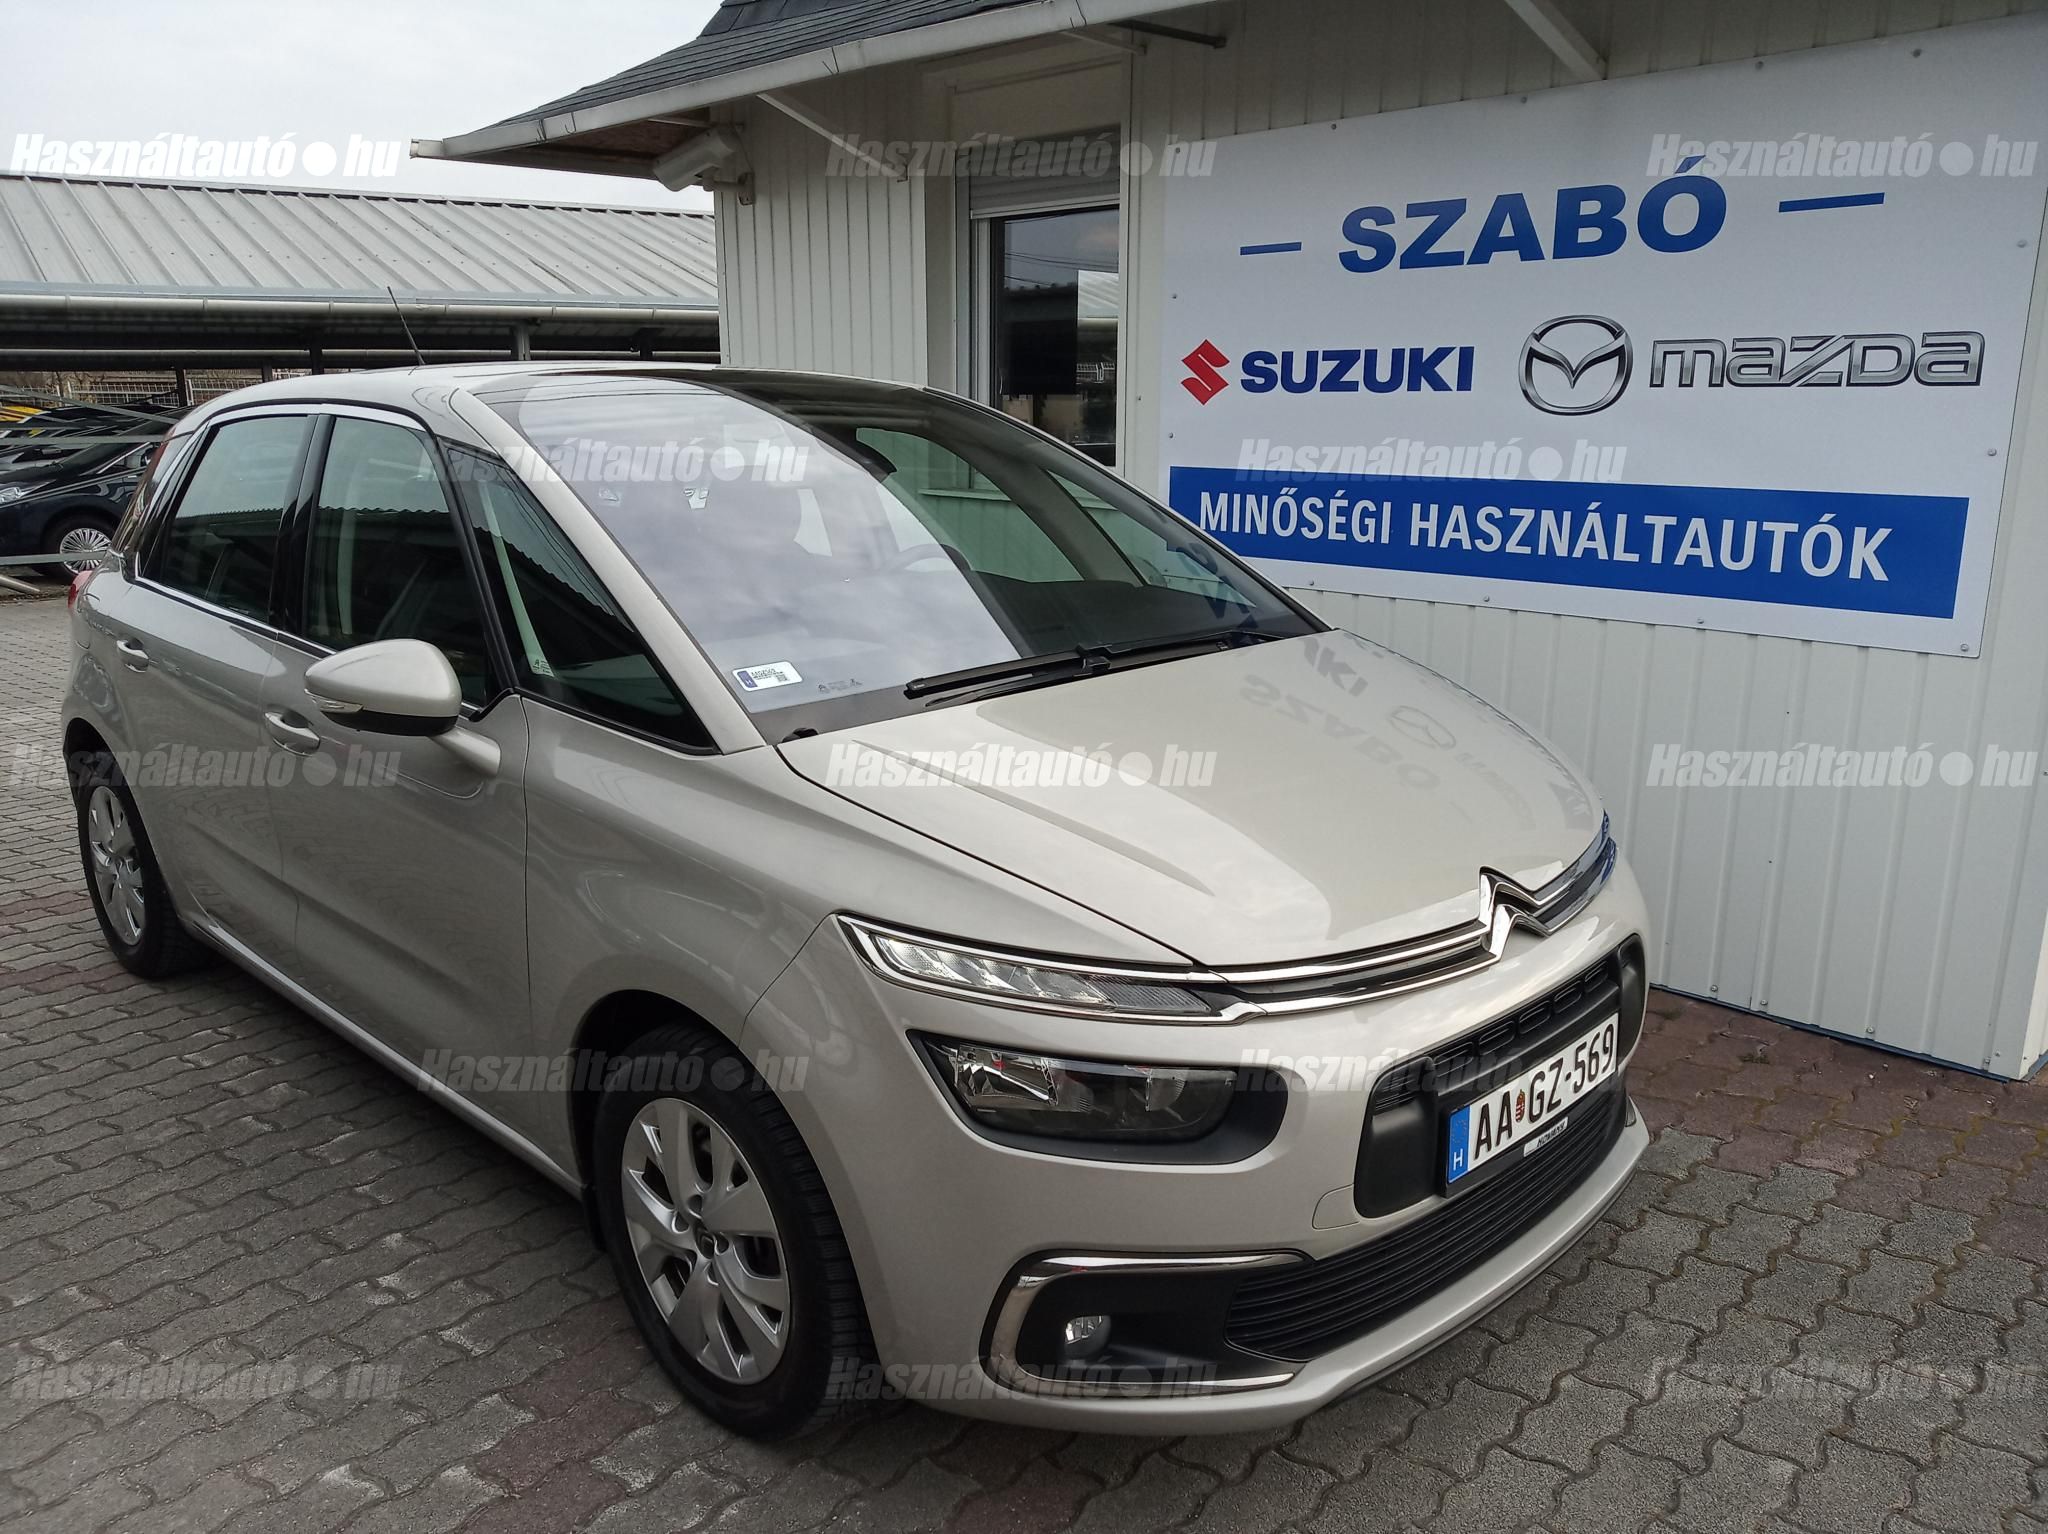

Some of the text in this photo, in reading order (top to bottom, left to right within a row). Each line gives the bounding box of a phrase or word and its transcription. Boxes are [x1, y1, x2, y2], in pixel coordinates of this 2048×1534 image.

[1338, 156, 1728, 273] SZABÓ
[1240, 345, 1475, 394] SUZUKI
[1199, 486, 1894, 583] MINŐSÉGI HASZNÁLTAUTÓK
[1452, 1149, 1464, 1171] H
